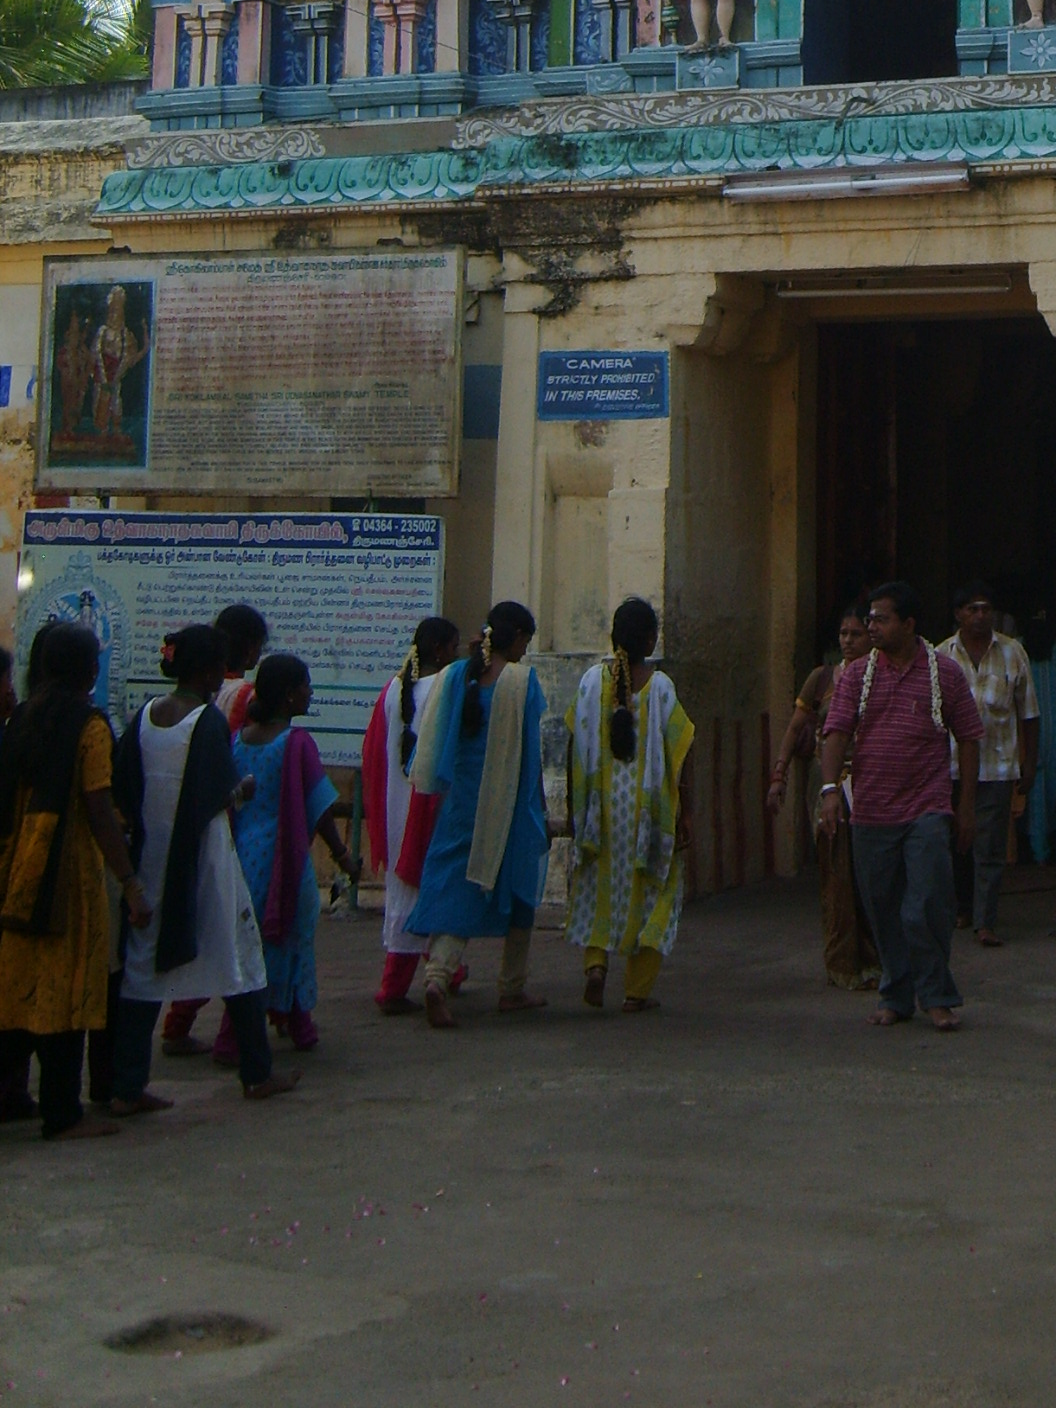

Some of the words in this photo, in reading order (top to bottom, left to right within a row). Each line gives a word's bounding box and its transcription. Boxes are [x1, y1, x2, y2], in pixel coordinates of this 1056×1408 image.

[547, 375, 599, 385] STRICTLY
[375, 389, 410, 399] TEMPLE
[544, 390, 559, 403] IN
[561, 390, 584, 402] THIS
[585, 389, 641, 401] PREMISES.
[27, 517, 100, 542] அருள்மிகு
[102, 518, 239, 545] உத்வாகநாதசுவாமி
[363, 519, 393, 533] 04364
[401, 519, 437, 534] 235002
[272, 551, 304, 566] திருமண
